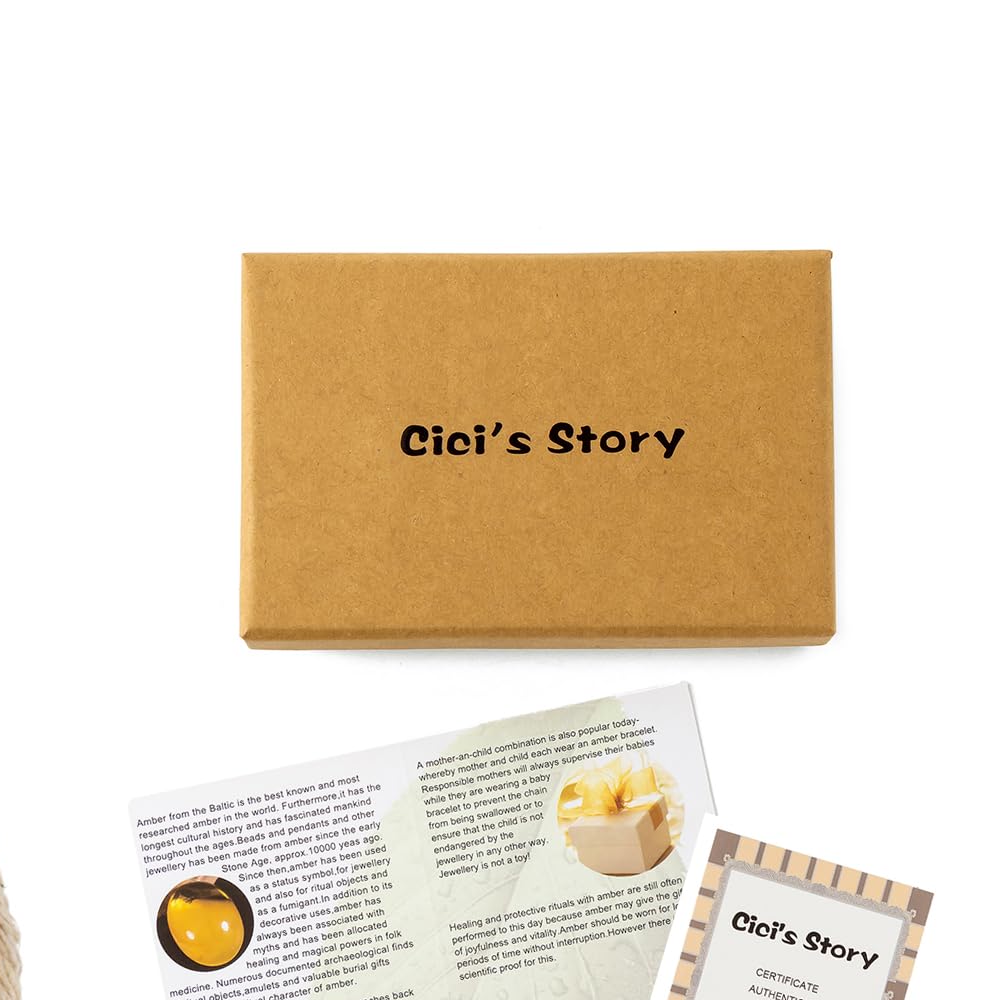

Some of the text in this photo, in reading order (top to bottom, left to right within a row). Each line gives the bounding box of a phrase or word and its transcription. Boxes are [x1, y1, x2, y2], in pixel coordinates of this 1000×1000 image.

[400, 422, 685, 459] Cici's Story
[416, 717, 640, 770] A mother-an-child combination is also popular today-
[418, 725, 658, 782] whereby mother and child each wear an amber bracelet.
[420, 739, 655, 794] Responsible mothers will always supervise their babies
[136, 774, 360, 828] Amber from the Baltic is the best known and most
[138, 821, 190, 840] researched
[192, 816, 221, 829] amber
[223, 814, 233, 822] in
[234, 811, 249, 820] the
[251, 803, 279, 816] world.
[347, 787, 365, 796] has
[366, 783, 381, 793] the
[425, 786, 548, 818] bracelet to prevent the chain
[221, 861, 249, 873] Stone
[338, 838, 361, 851] yeas
[362, 834, 383, 845] ago.
[435, 837, 549, 869] jewellery in any other way.
[438, 851, 531, 879] Jewellery is not a toy!
[257, 907, 269, 917] as
[270, 906, 277, 914] a
[332, 887, 369, 901] addition
[370, 884, 380, 893] to
[381, 882, 393, 890] its
[448, 877, 683, 932] Healing and protective rituals with amber are still often
[451, 927, 497, 946] performed
[498, 926, 508, 935] to
[508, 922, 526, 932] this
[526, 919, 544, 929] day
[544, 910, 583, 925] because
[584, 904, 613, 917] amber
[614, 900, 634, 910] may
[635, 896, 654, 908] give
[655, 892, 671, 902] the
[731, 911, 879, 970] Cici's Story
[169, 940, 414, 998] medicine. Numerous documented archaeological finds
[458, 954, 557, 981] scientific proof for this.
[755, 967, 820, 994] CERTIFICATE
